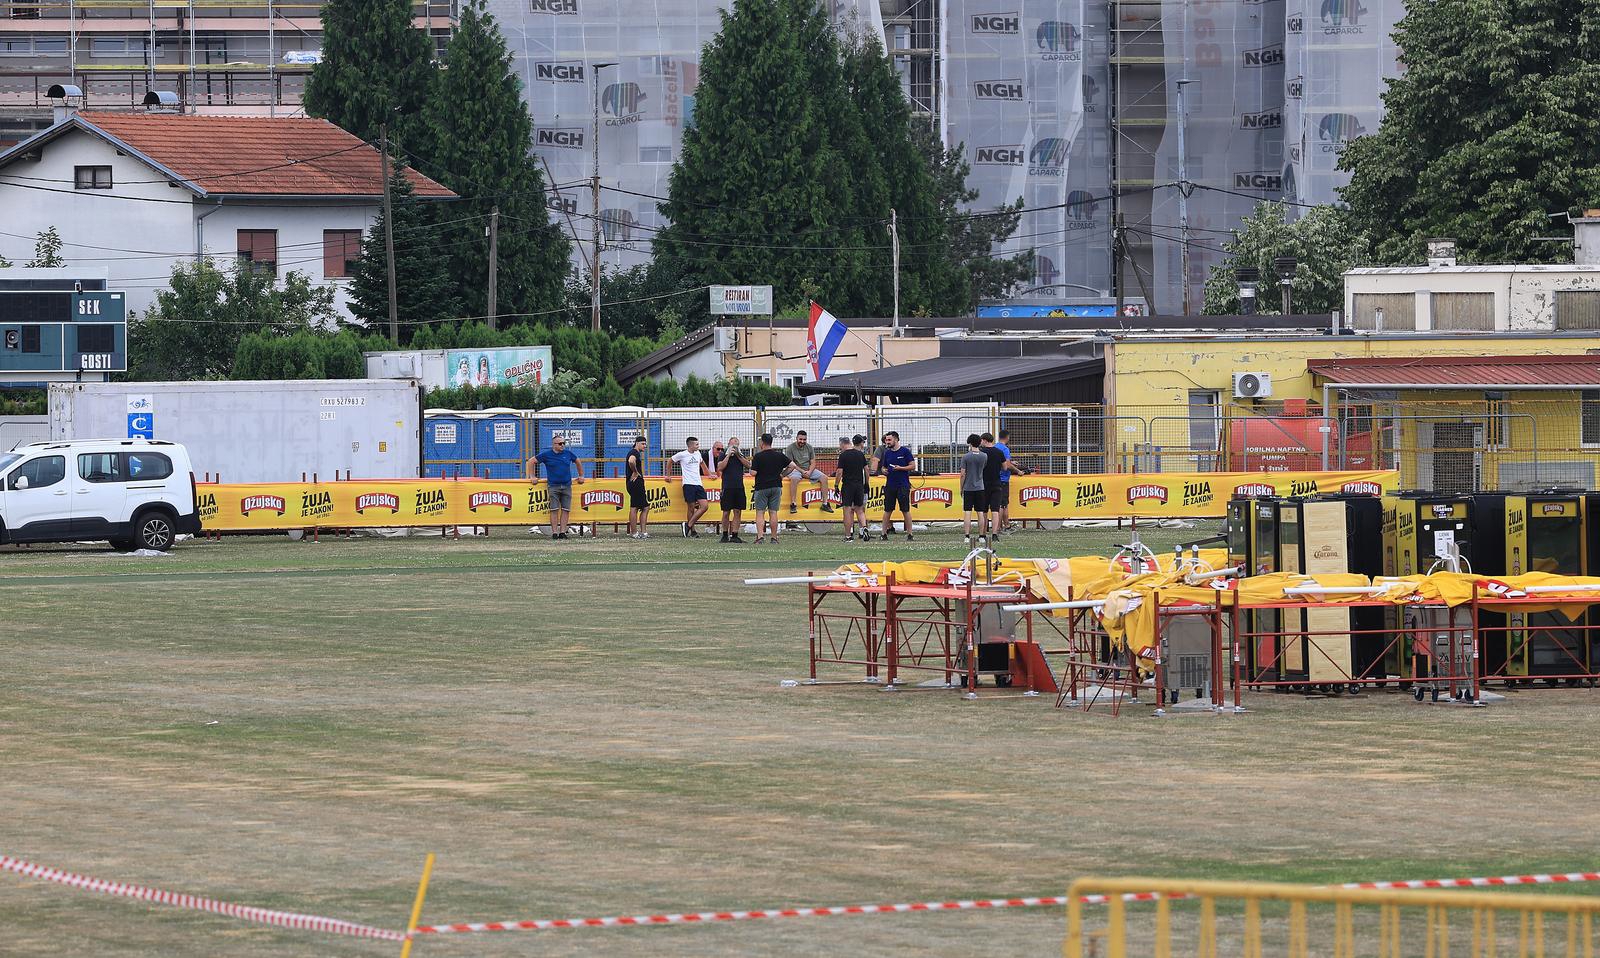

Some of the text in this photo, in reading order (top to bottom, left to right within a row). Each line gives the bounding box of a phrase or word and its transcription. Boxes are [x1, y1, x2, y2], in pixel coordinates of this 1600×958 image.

[532, 0, 578, 12] NGH
[974, 17, 1018, 30] NGH
[1042, 52, 1080, 62] CAPAROL
[1245, 50, 1283, 64] NGH
[538, 65, 584, 79] NGH
[976, 84, 1023, 97] NGH
[1243, 112, 1281, 127] NGH
[539, 131, 583, 146] NGH
[978, 150, 1024, 163] NGH
[1291, 148, 1299, 162] GH
[1029, 168, 1065, 177] CAPAROL
[1236, 174, 1281, 188] NGH
[548, 197, 577, 214] GH
[79, 300, 100, 314] SEK
[81, 354, 111, 368] GOSTI
[504, 359, 544, 379] ODLIČNO
[647, 487, 668, 502] UJA
[867, 486, 885, 500] UJA
[914, 488, 949, 502] Ožujsko
[1023, 487, 1057, 501] Ožujsko
[1076, 482, 1104, 499] ŽUJA
[1130, 485, 1165, 499] Ožujsko
[1184, 481, 1211, 497] ŽUJA
[1291, 480, 1317, 496] ŽUJA
[198, 494, 216, 508] UJA
[244, 495, 282, 510] Ožujsko
[302, 490, 331, 509] ŽUJA
[359, 494, 396, 508] Ožujsko
[416, 488, 444, 506] ŽUJA
[473, 492, 508, 506] Ožujsko
[528, 488, 548, 505] ŽUJ
[584, 490, 620, 505] Ožujsko
[1083, 495, 1106, 506] ZAKON!
[1183, 498, 1189, 506] JE
[1191, 494, 1214, 505] ZAKON!
[199, 506, 219, 516] AKON!
[301, 504, 334, 517] JE ZAKON!
[415, 507, 422, 515] JE
[423, 502, 447, 513] ZAKON!
[528, 505, 534, 513] JE
[650, 500, 671, 510] AKON!
[1509, 509, 1523, 526] ŽUJA
[1314, 550, 1338, 558] Corona
